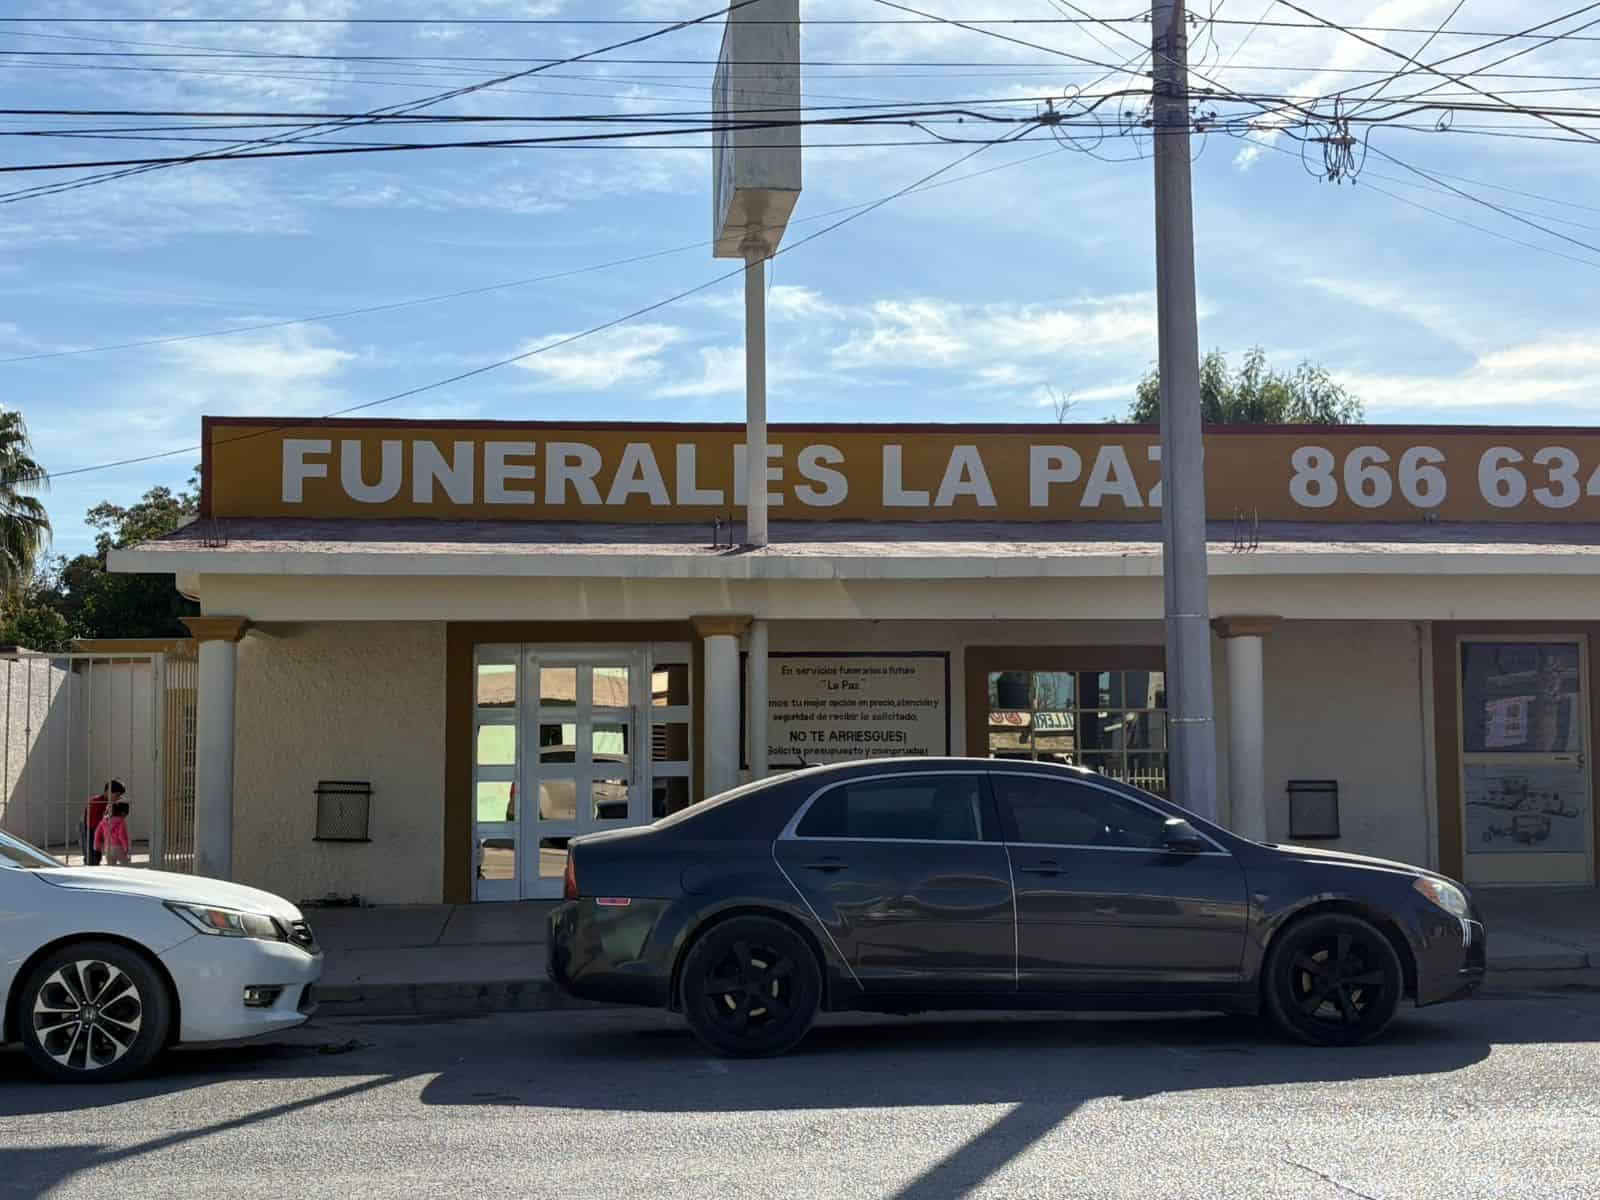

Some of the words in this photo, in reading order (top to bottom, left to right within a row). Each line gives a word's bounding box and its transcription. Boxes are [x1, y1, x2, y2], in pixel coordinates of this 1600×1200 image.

[281, 438, 849, 507] FUNERALES
[881, 444, 998, 507] LA
[1029, 444, 1204, 507] PA
[1289, 445, 1448, 508] 866
[1478, 445, 1600, 508] 63
[781, 665, 793, 676] En
[795, 665, 837, 676] servicios
[772, 713, 815, 723] seguridad
[816, 713, 828, 722] de
[789, 731, 807, 743] NO
[810, 731, 825, 743] TE
[803, 746, 863, 757] presupuesto
